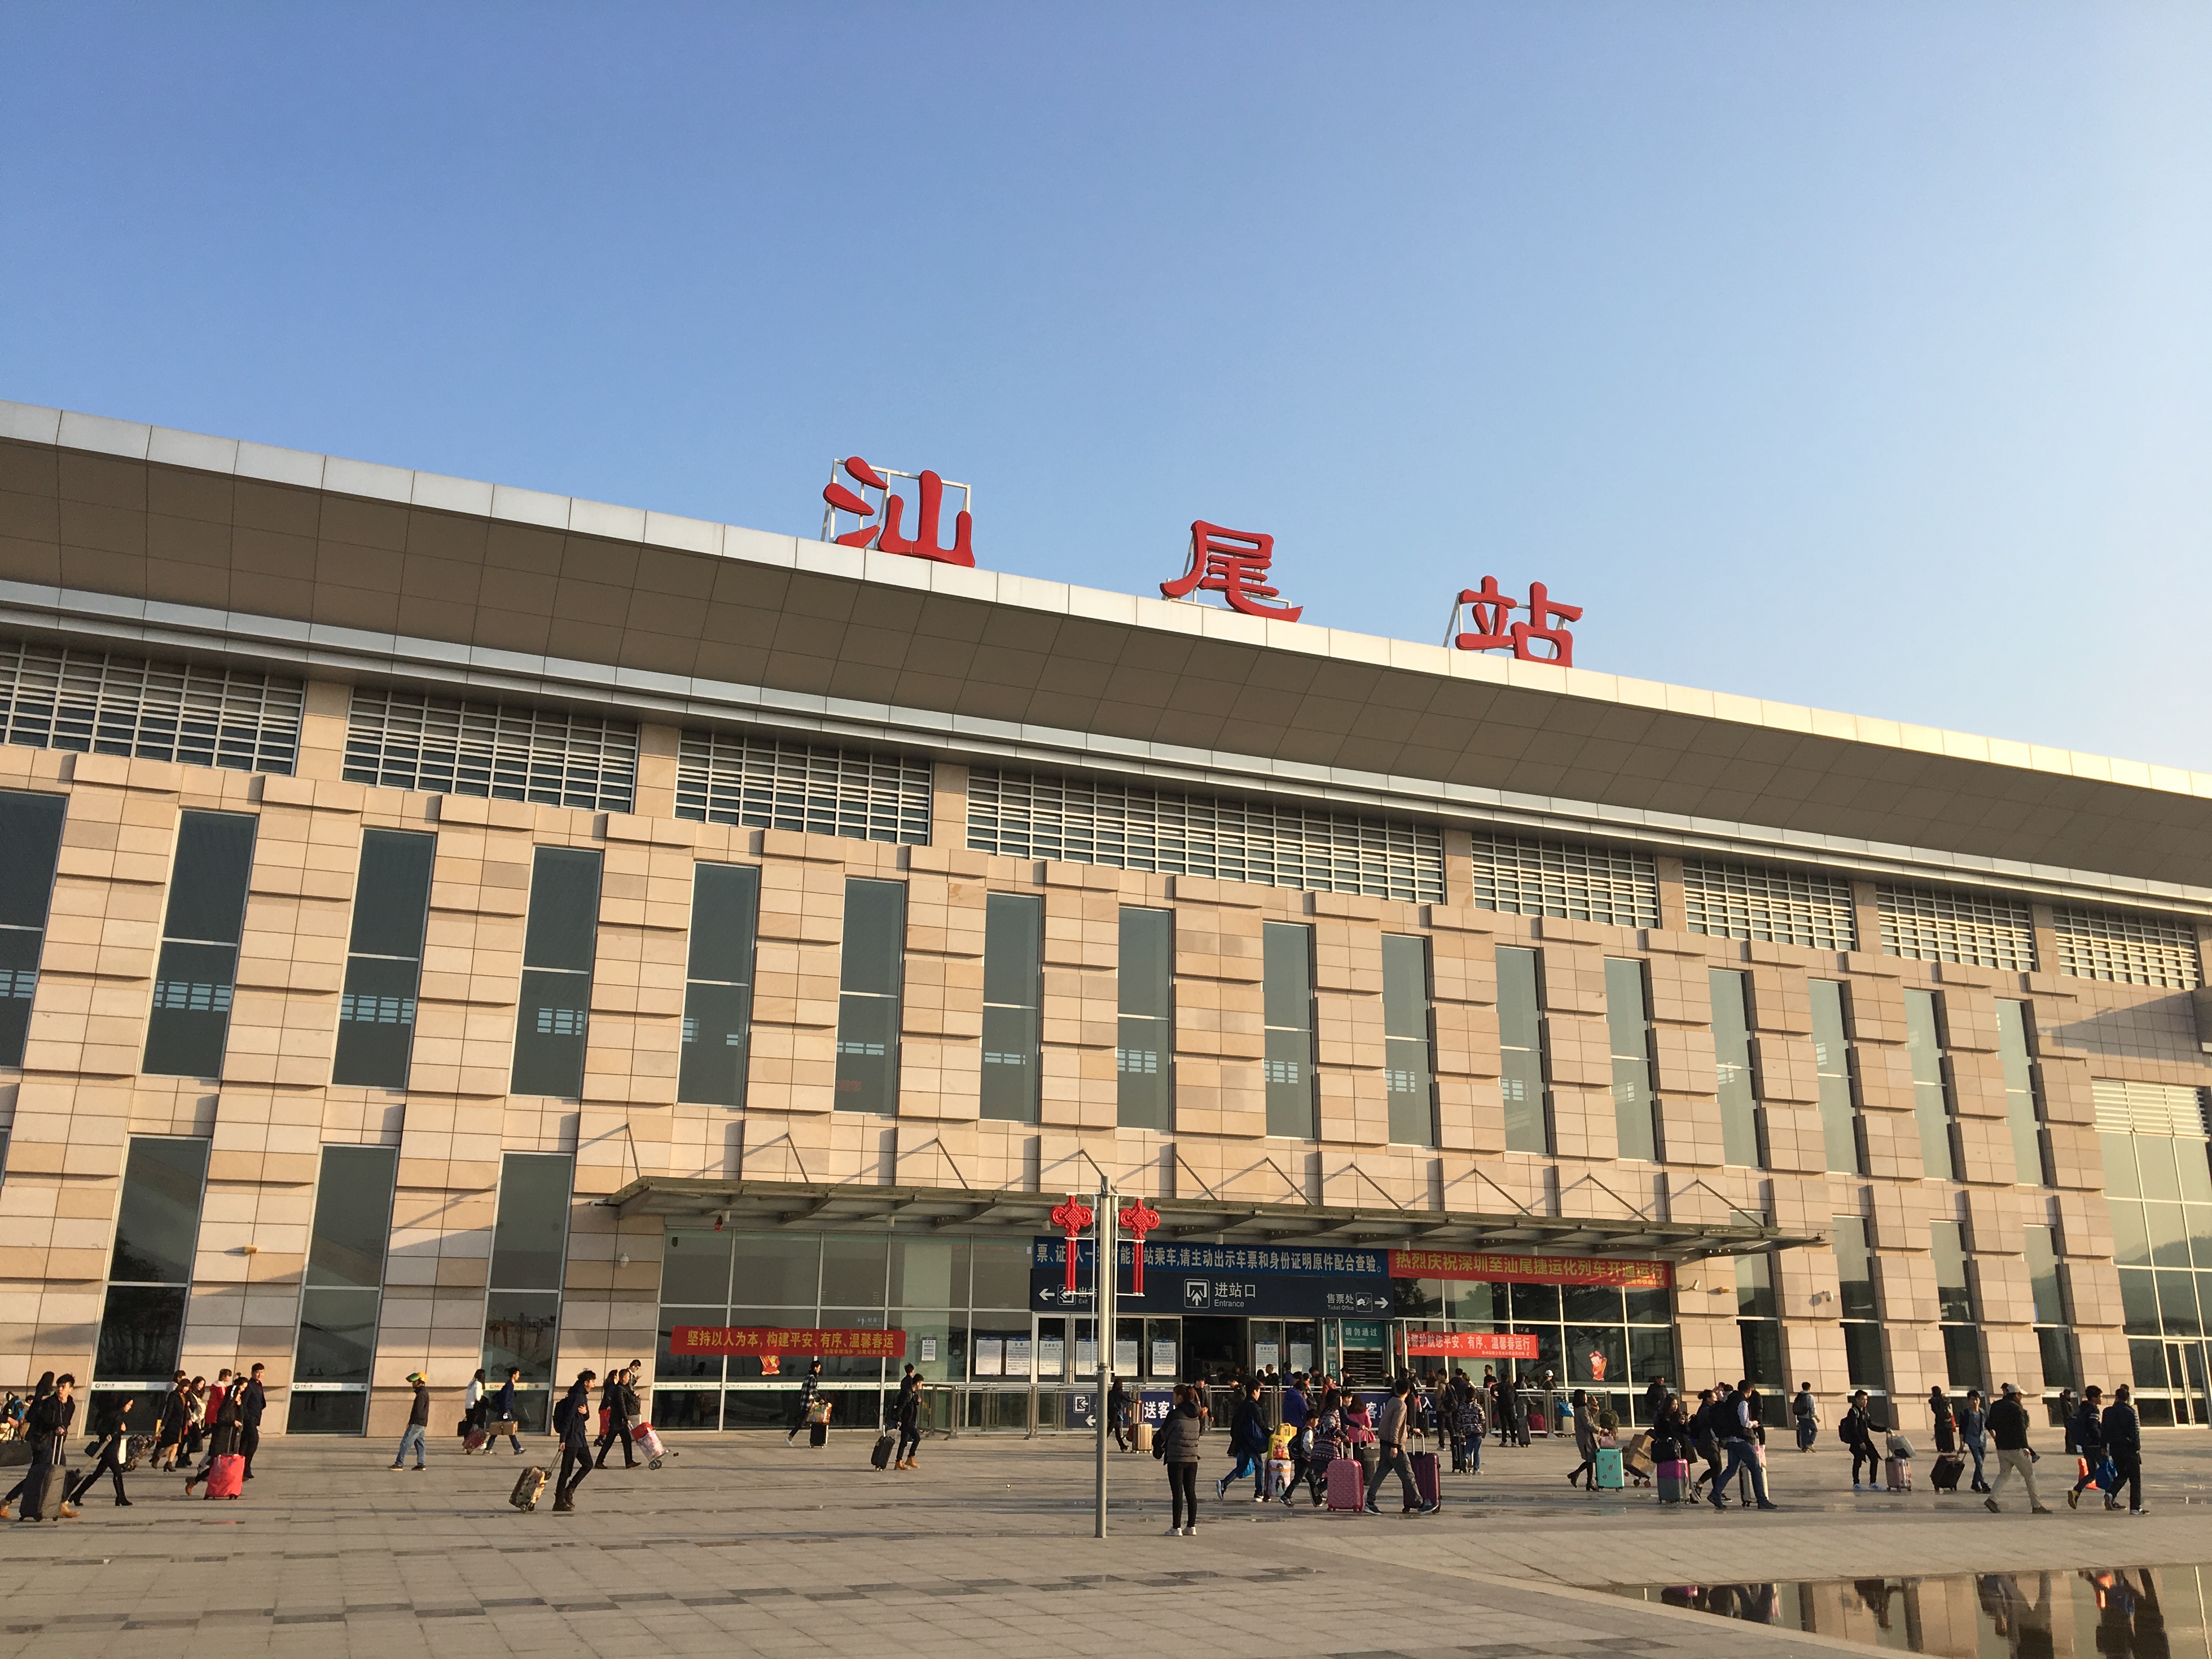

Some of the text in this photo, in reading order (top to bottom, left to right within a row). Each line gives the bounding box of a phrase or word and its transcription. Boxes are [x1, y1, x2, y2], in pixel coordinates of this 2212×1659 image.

[823, 456, 1583, 668] 汕尾站
[1396, 1252, 1664, 1279] 热烈庆祝深圳至汕尾捷运化列车开通运行
[1215, 1282, 1256, 1298] 进站口
[1327, 1293, 1354, 1305] 售票处
[1345, 1328, 1378, 1336] 请勿通过
[1144, 1401, 1176, 1419] 送客
